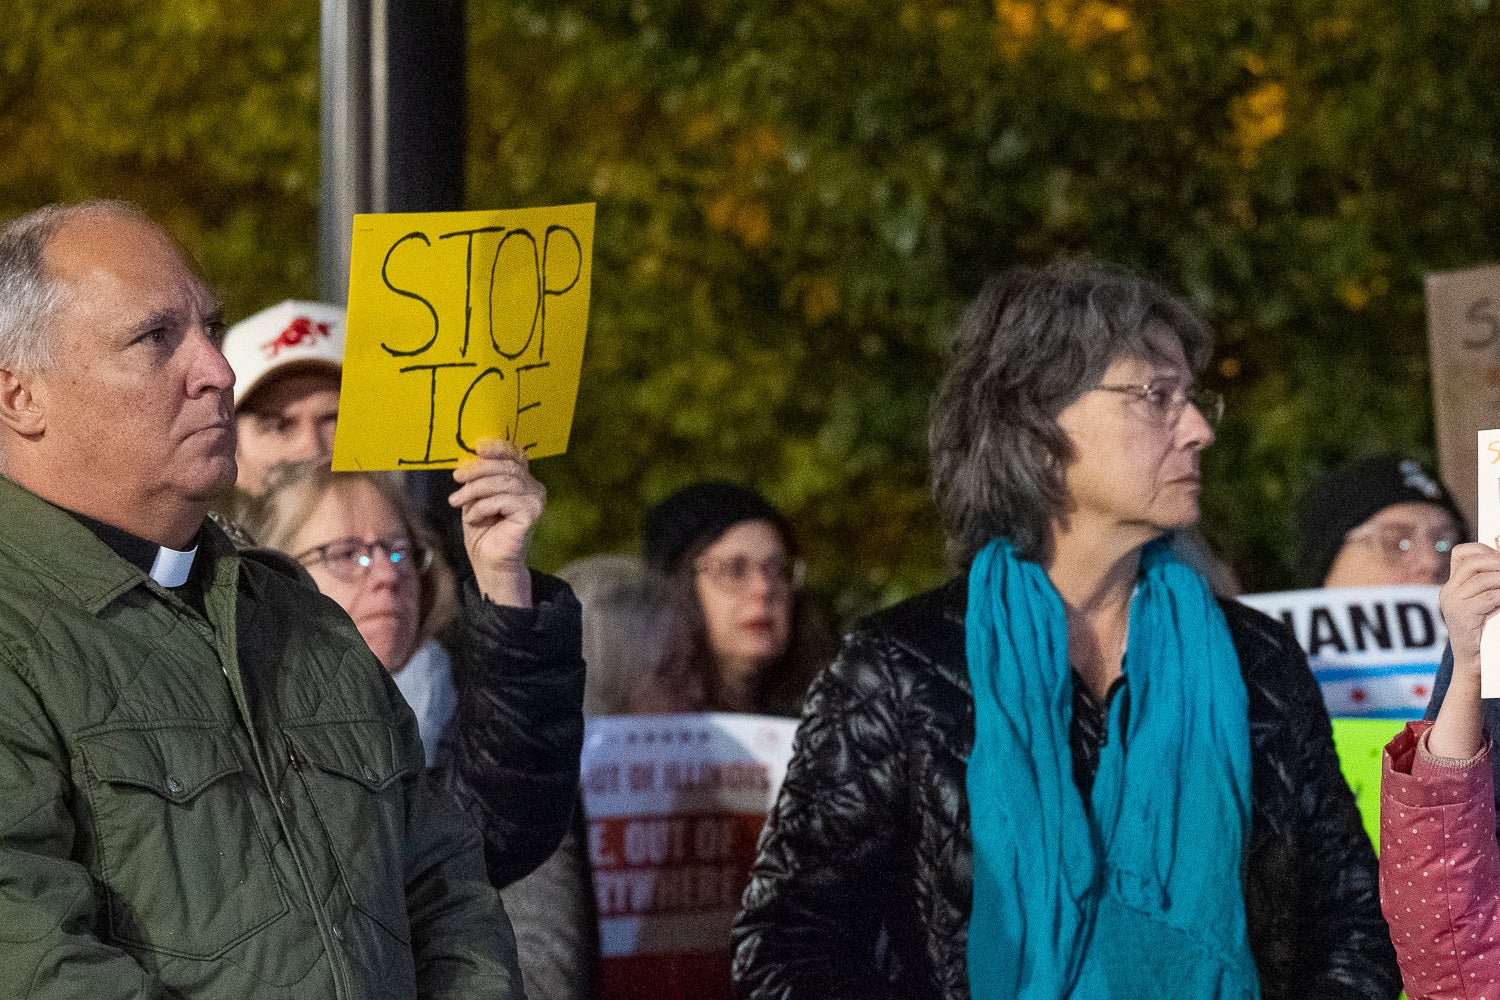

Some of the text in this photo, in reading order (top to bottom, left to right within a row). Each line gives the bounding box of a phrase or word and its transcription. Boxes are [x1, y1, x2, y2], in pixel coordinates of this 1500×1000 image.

[381, 224, 583, 361] STOP
[398, 360, 551, 466] ICE
[1279, 602, 1438, 656] AND
